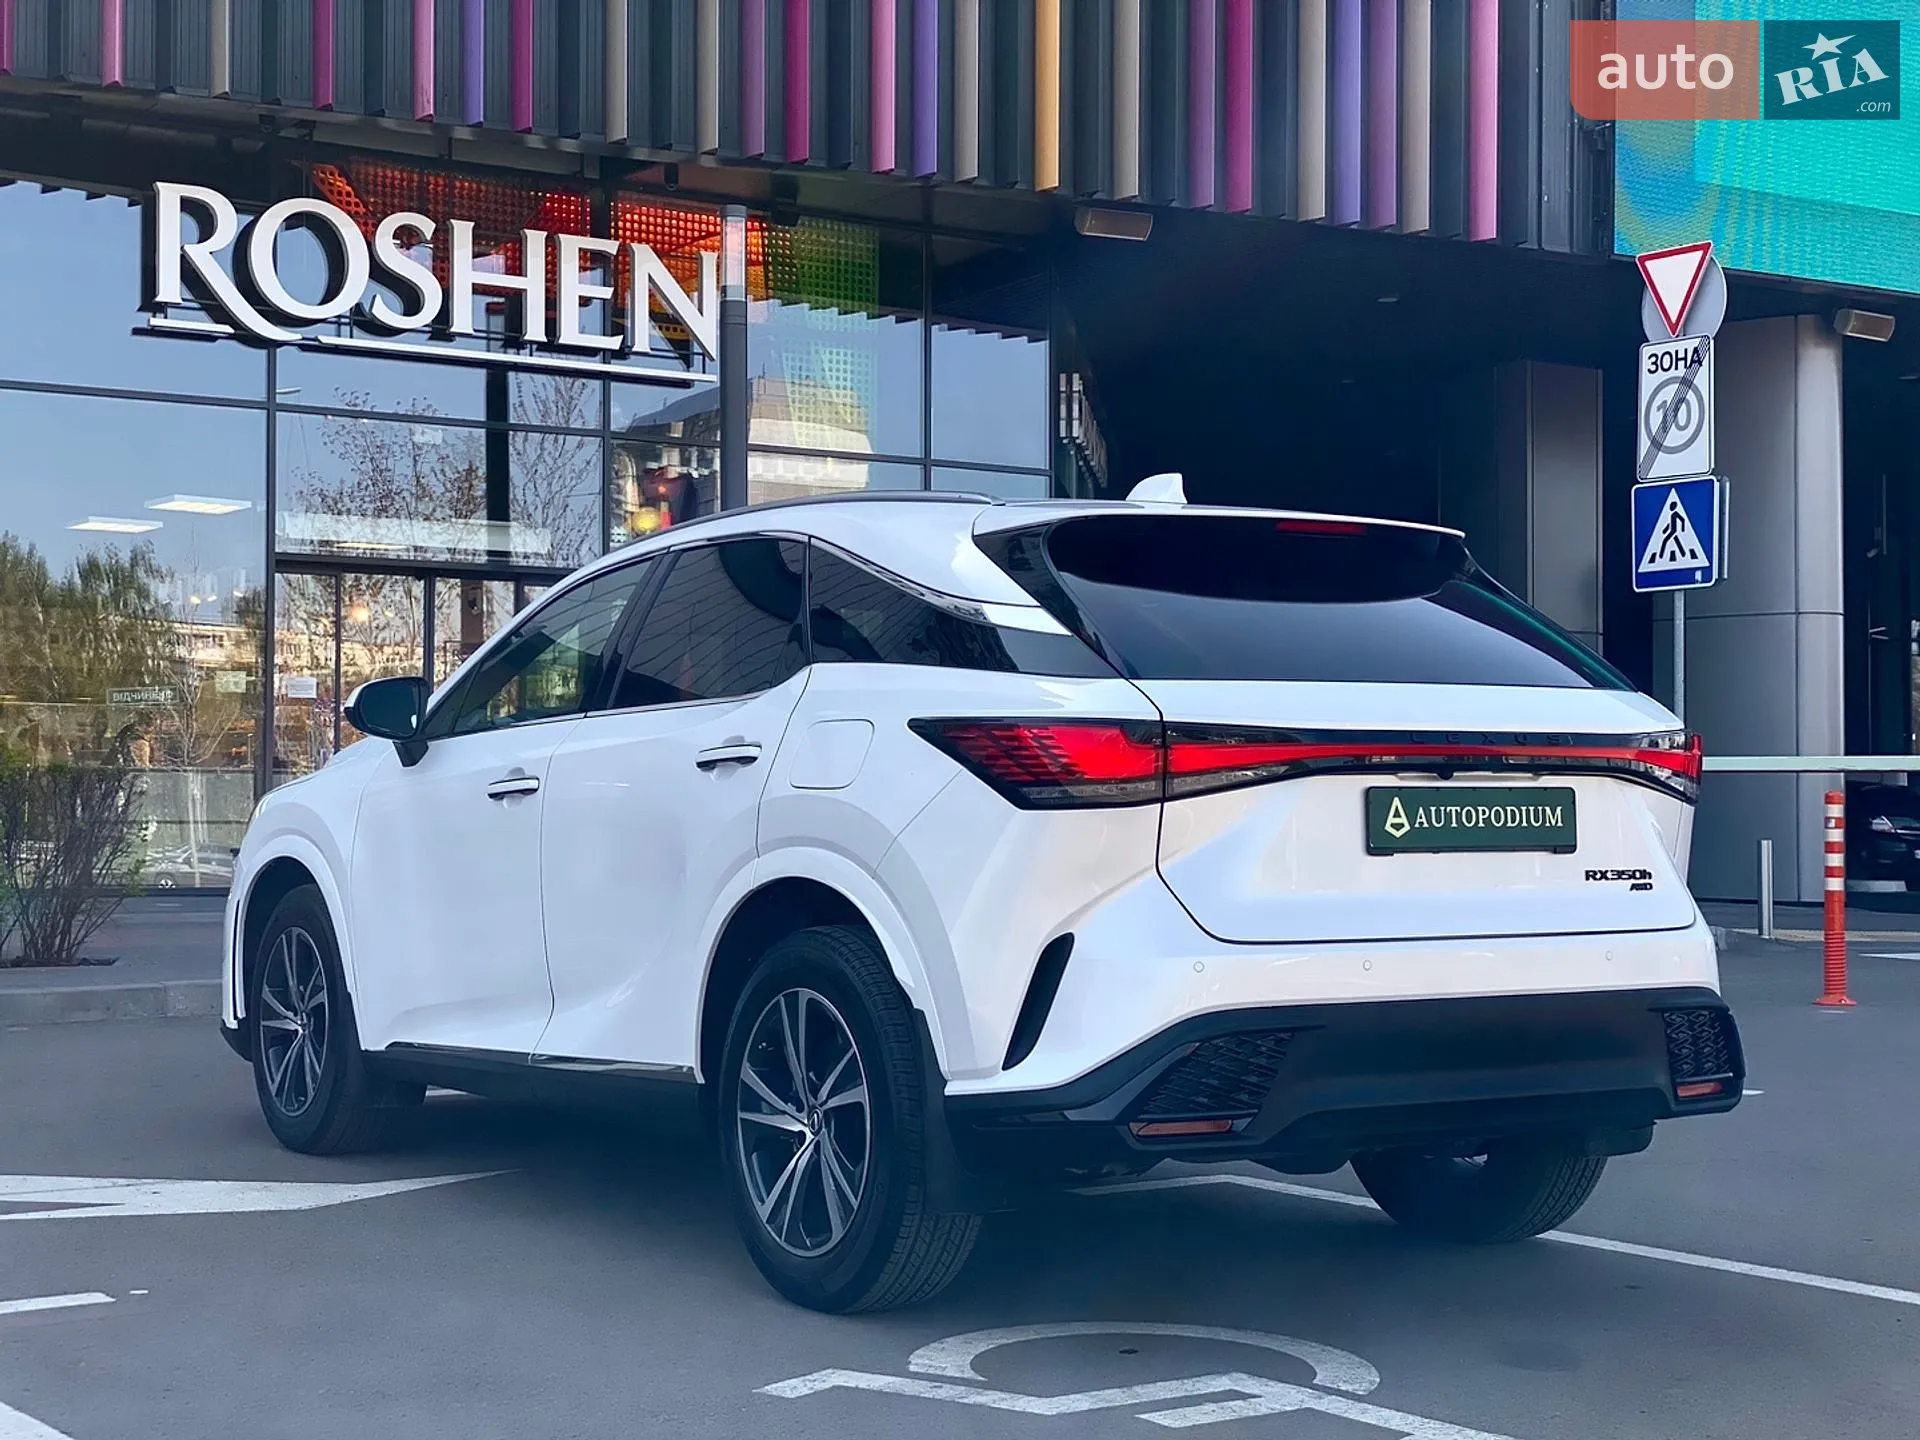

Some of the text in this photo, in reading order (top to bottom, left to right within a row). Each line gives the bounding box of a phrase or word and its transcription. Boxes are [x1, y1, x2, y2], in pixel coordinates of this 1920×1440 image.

[153, 180, 718, 361] ROSHEN
[1647, 347, 1703, 374] ЗОНА
[1656, 398, 1692, 432] 10
[1408, 732, 1561, 746] LEXUS
[1414, 806, 1563, 828] AUTOPODIUM
[1585, 869, 1653, 881] RX350h
